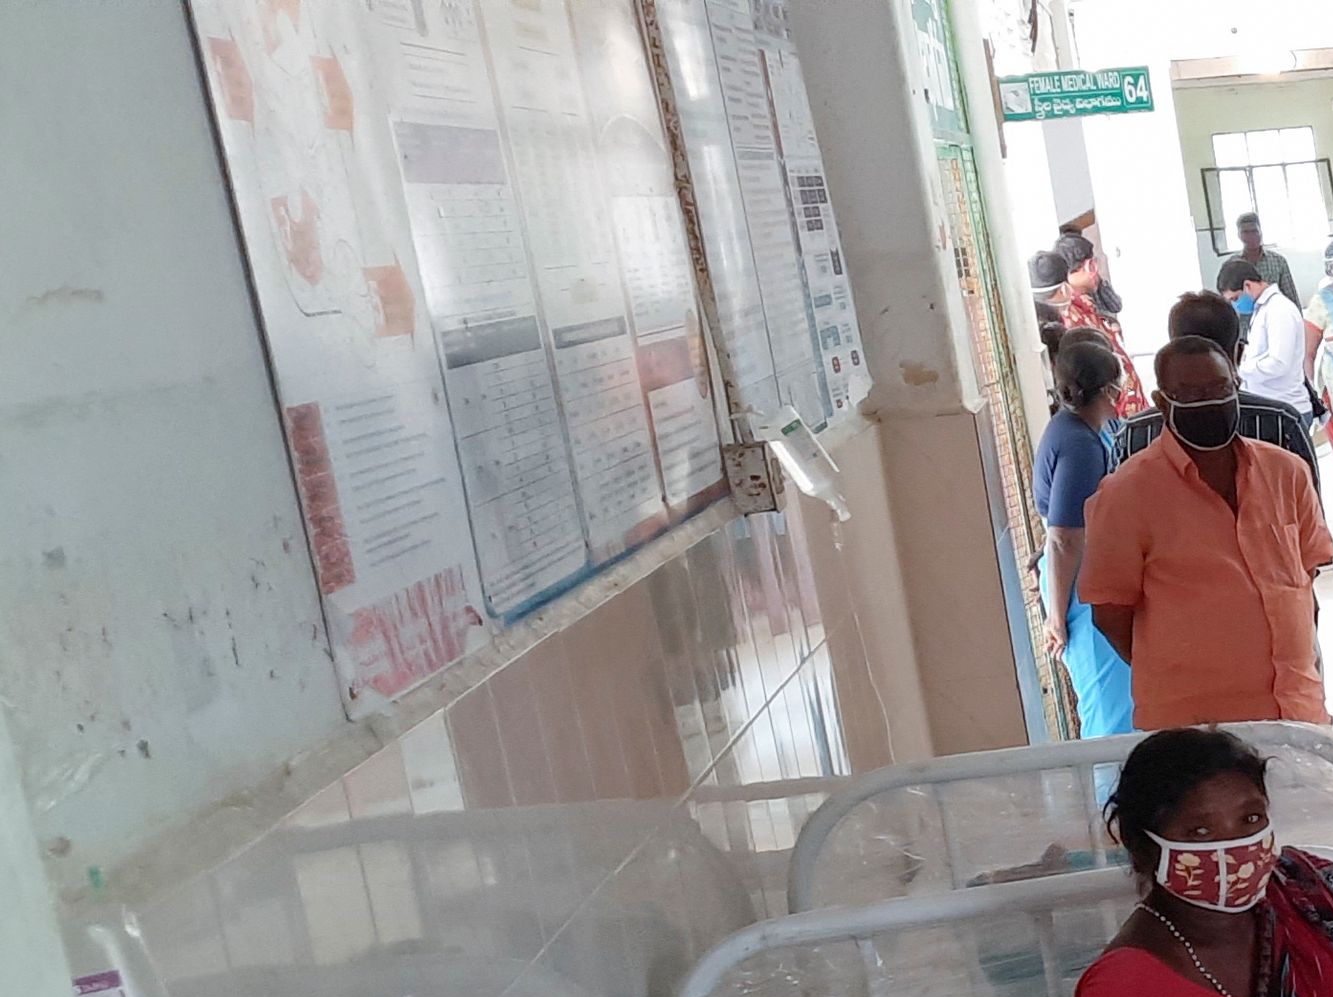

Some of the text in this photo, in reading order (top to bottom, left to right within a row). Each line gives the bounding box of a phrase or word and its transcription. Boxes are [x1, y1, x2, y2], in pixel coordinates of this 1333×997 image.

[1028, 72, 1120, 94] FEMALE MEDICAL WARD
[1123, 75, 1148, 103] 64
